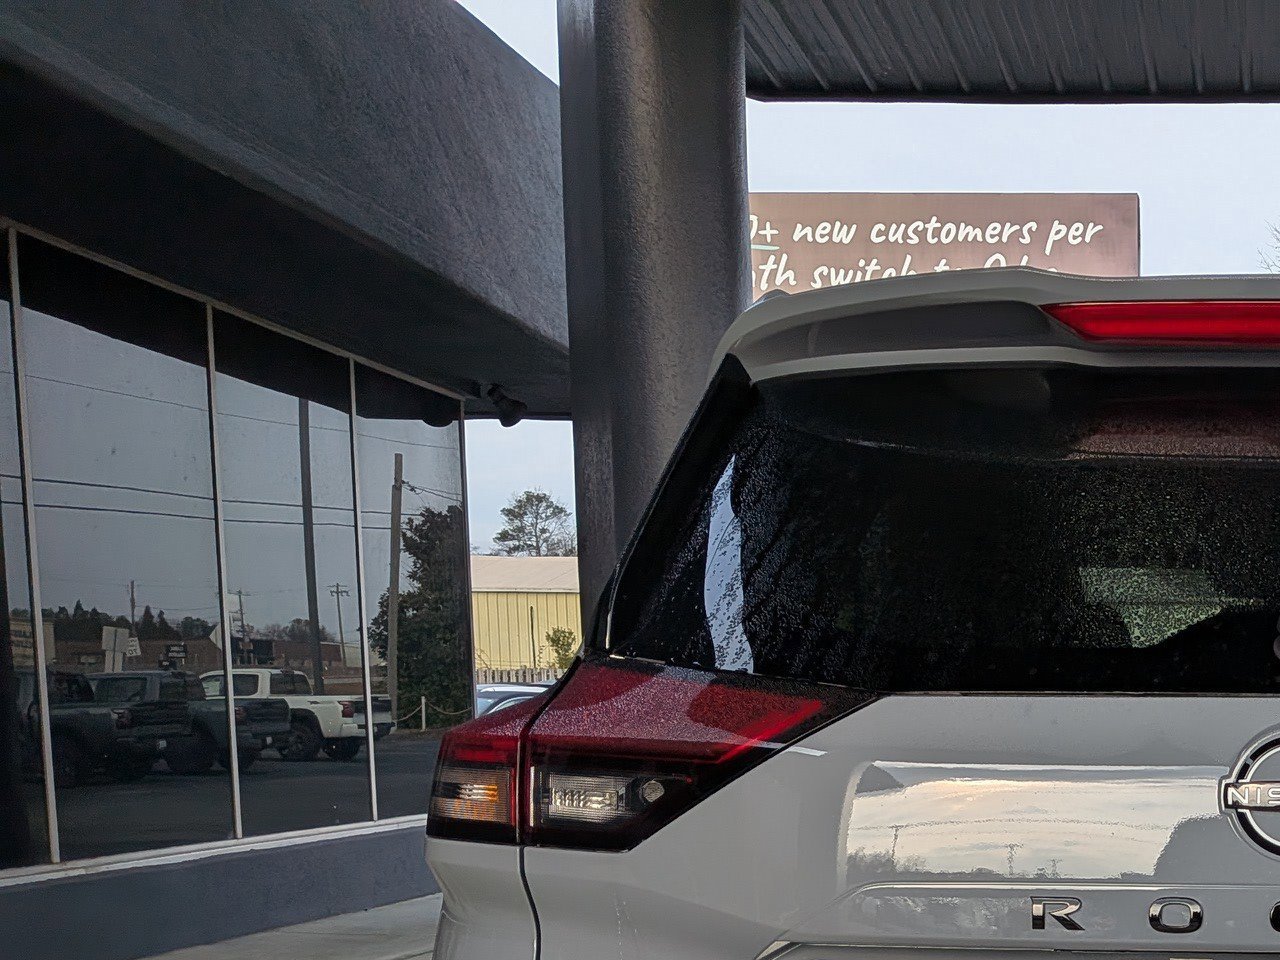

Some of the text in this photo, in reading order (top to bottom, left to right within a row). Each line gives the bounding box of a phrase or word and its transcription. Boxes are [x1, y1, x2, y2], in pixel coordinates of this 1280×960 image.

[793, 221, 857, 244] new
[870, 216, 1037, 244] customers
[1045, 220, 1103, 256] per
